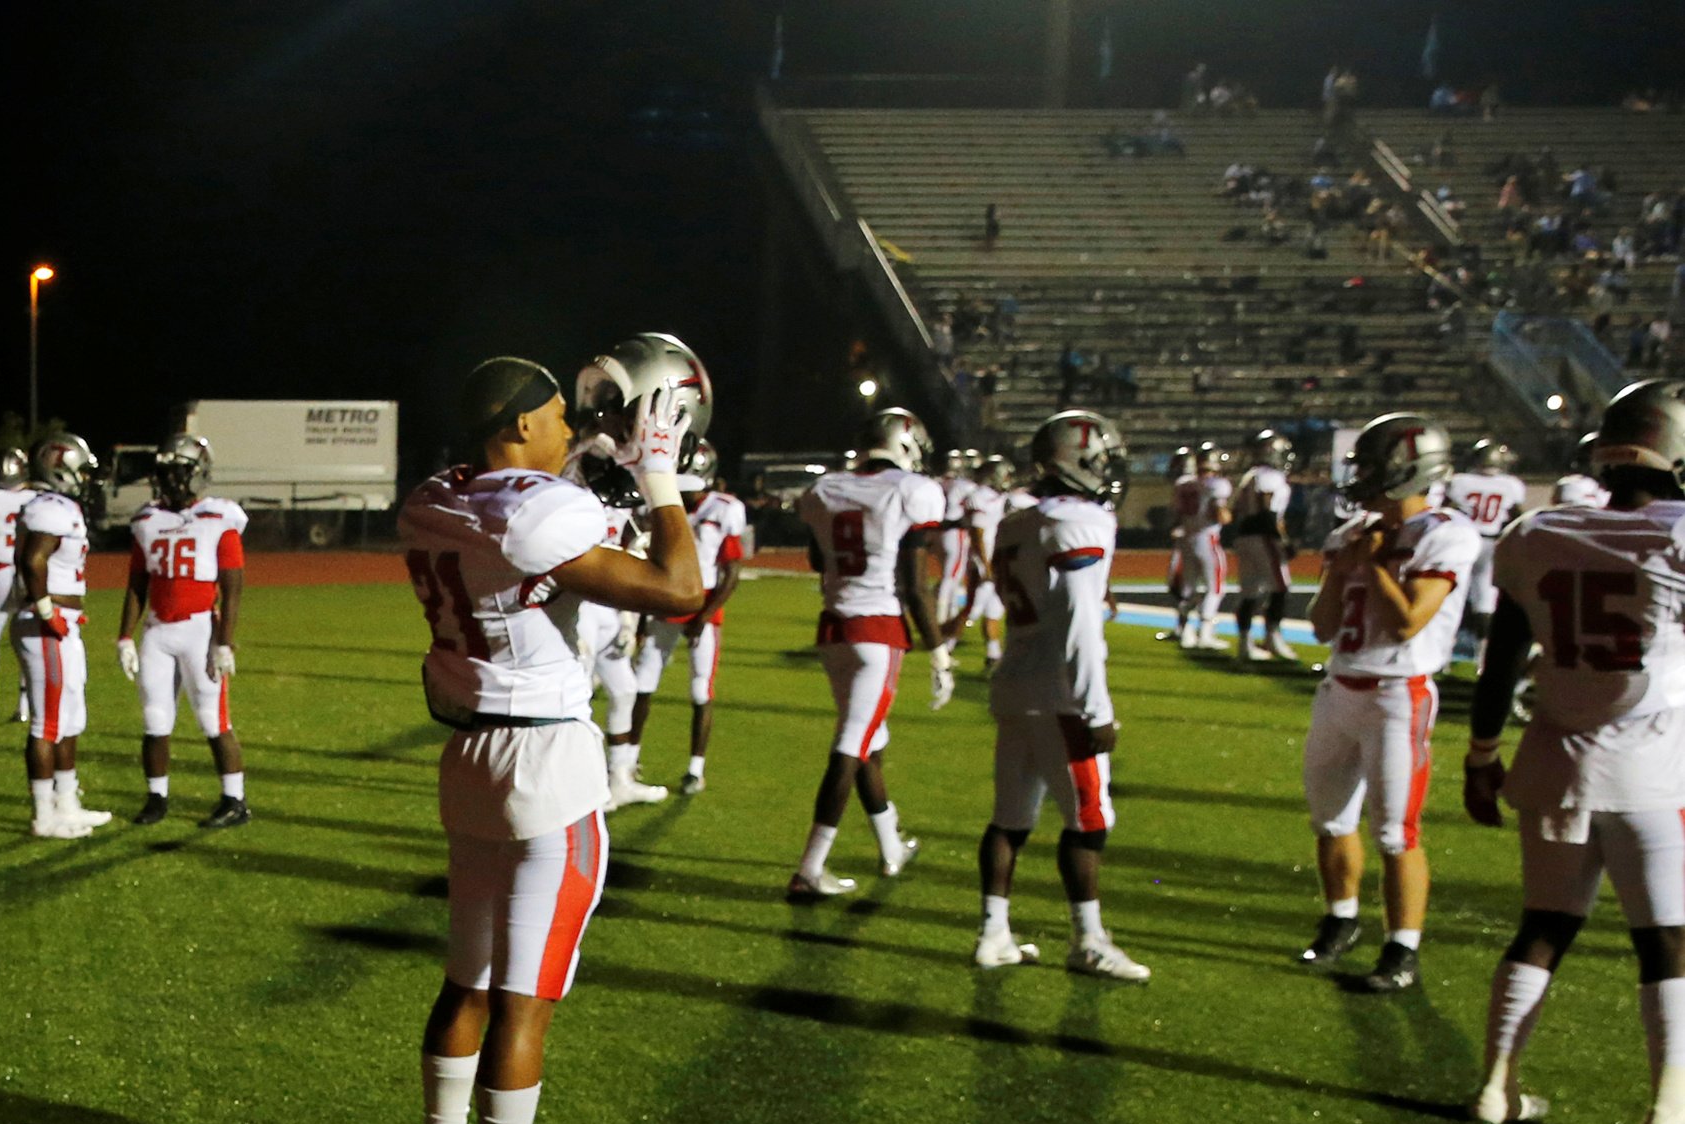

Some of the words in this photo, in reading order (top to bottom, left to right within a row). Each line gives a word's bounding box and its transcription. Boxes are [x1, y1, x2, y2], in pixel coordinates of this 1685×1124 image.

[306, 409, 380, 423] METRO
[1068, 418, 1099, 449] T
[1388, 428, 1426, 461] T
[1466, 493, 1502, 523] 30
[150, 538, 196, 578] 36
[1537, 569, 1644, 671] 15
